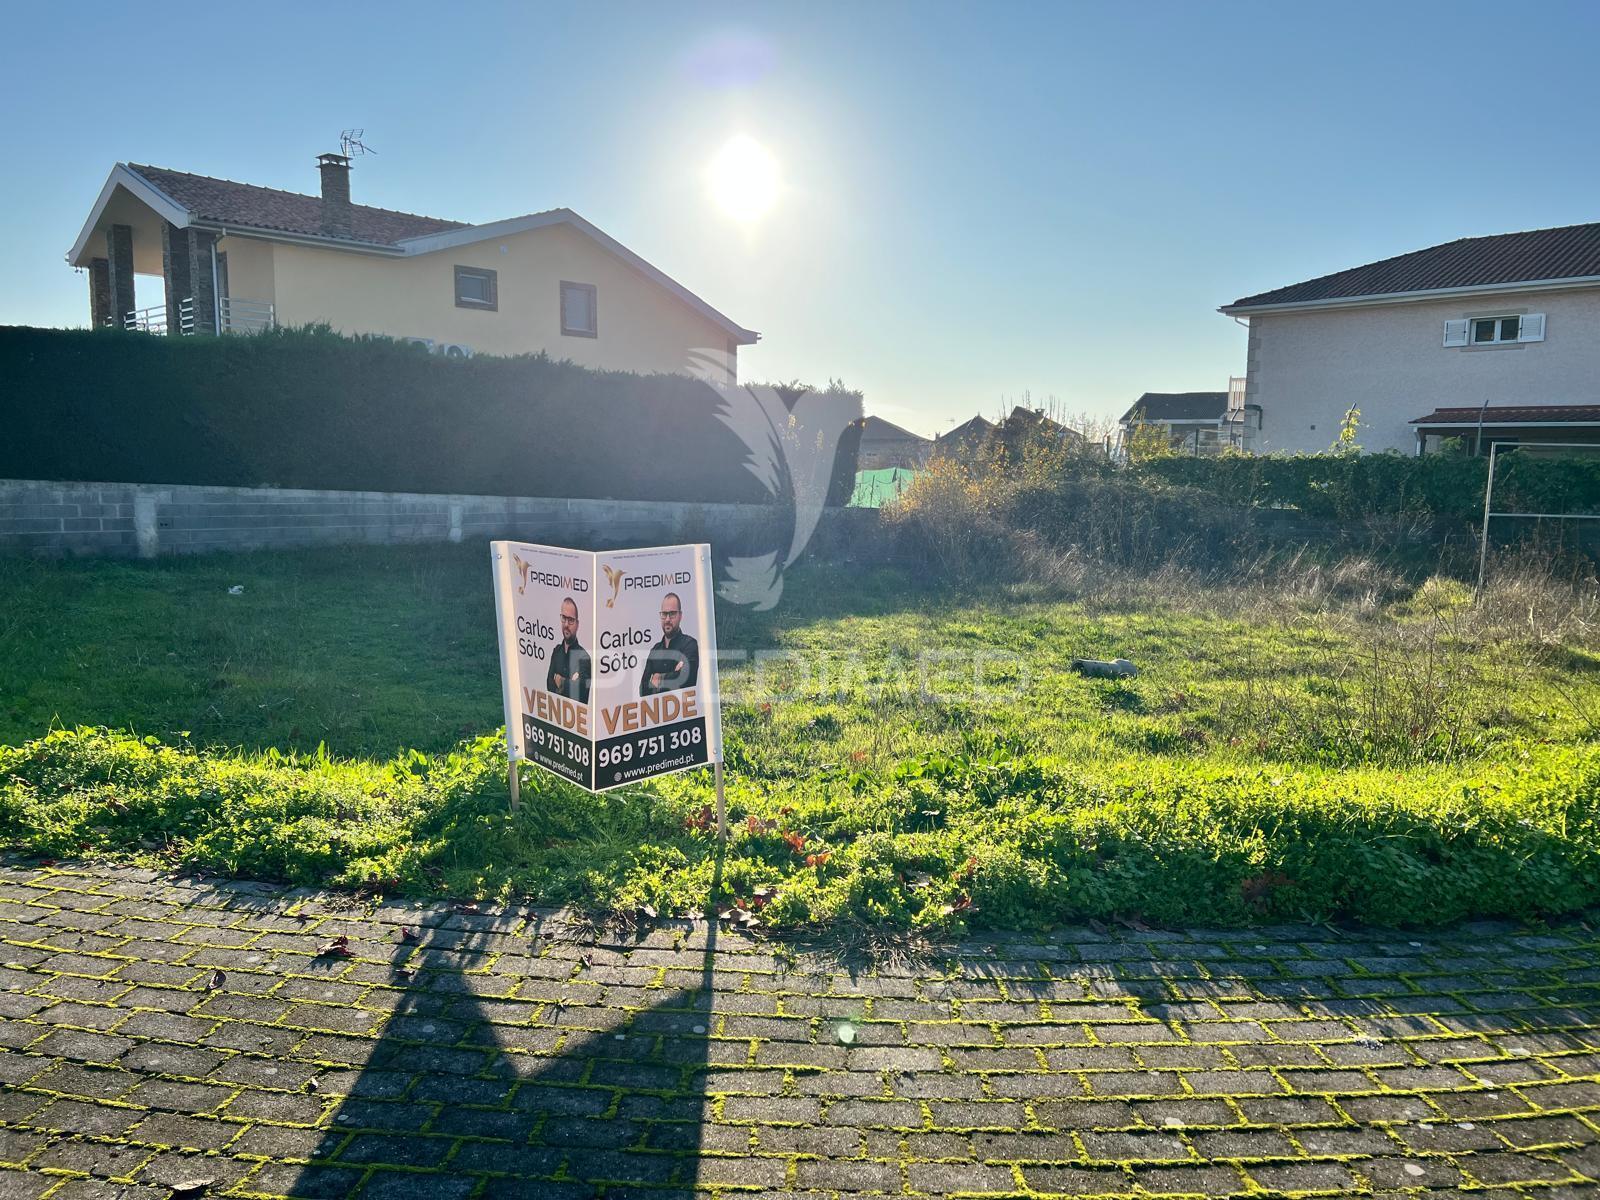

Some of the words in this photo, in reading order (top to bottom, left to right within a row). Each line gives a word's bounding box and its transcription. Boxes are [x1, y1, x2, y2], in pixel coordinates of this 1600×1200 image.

[531, 571, 589, 592] PREDIMED
[625, 572, 691, 590] PREDIMED
[517, 616, 554, 641] Carlos
[600, 627, 651, 649] Carlos
[519, 638, 545, 661] Sôto
[600, 653, 638, 674] Sôto
[523, 686, 588, 736] VENDE
[601, 690, 697, 735] VENDE
[525, 723, 544, 745] 969
[547, 732, 564, 756] 751
[568, 742, 589, 767] 308
[599, 743, 632, 768] 969
[638, 733, 665, 758] 751
[670, 726, 702, 751] 308
[540, 754, 583, 782] www.predimed.pt
[624, 754, 694, 779] www.predimed.pt
